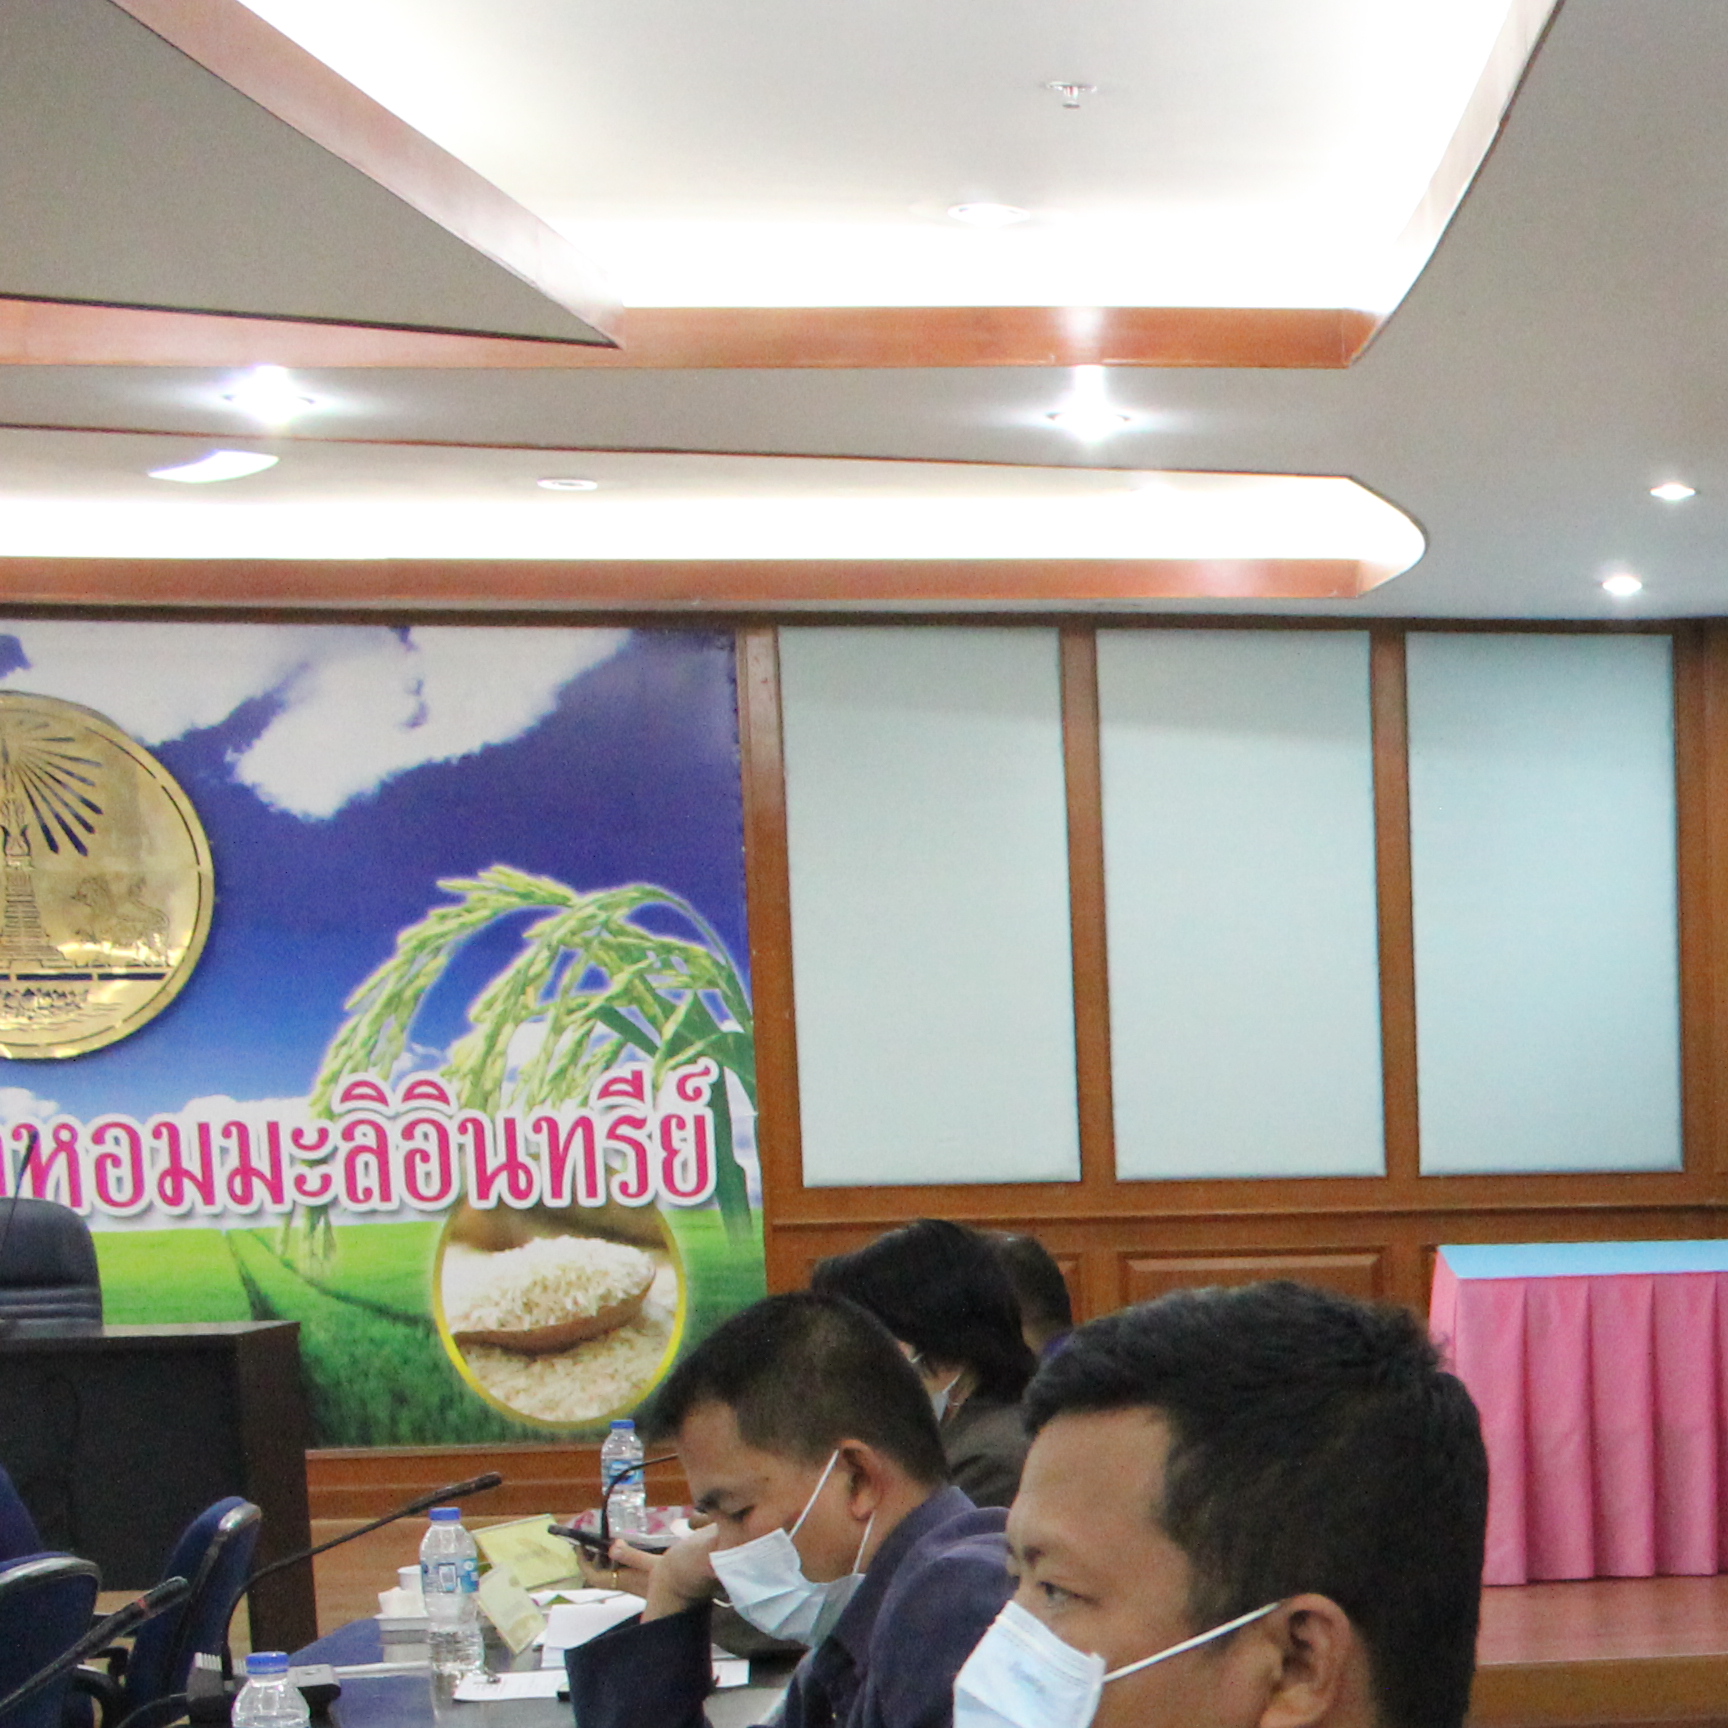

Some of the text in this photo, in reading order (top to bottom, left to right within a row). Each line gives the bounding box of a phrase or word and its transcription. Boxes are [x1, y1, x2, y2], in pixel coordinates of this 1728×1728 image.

[0, 1062, 717, 1208] หอมมะลิอินทรีย์
